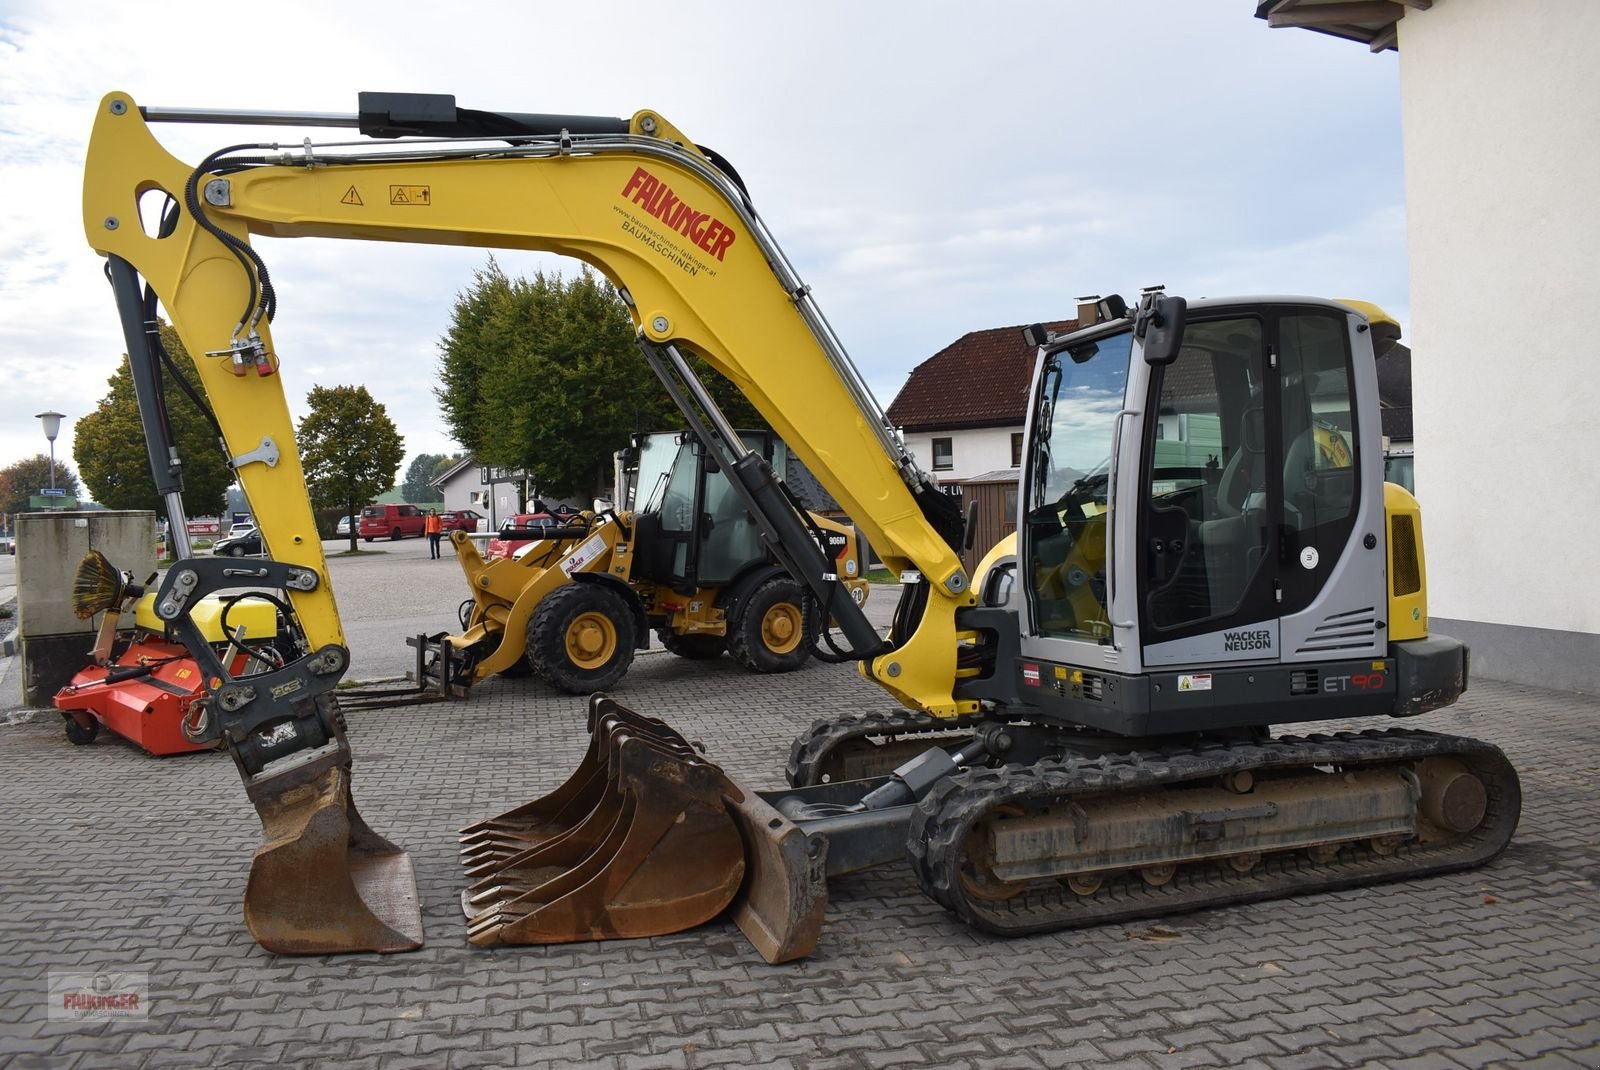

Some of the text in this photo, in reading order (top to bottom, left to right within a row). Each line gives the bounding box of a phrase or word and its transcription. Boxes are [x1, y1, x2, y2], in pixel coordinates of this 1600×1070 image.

[621, 166, 736, 263] FALKINGER
[613, 204, 717, 277] www.baumaschinen-falkinger.at
[621, 221, 698, 276] BAUMASCHINEN
[828, 536, 846, 545] 906M
[1224, 630, 1271, 642] WACKER
[1224, 640, 1271, 652] NEUSON
[1323, 673, 1385, 693] ET90
